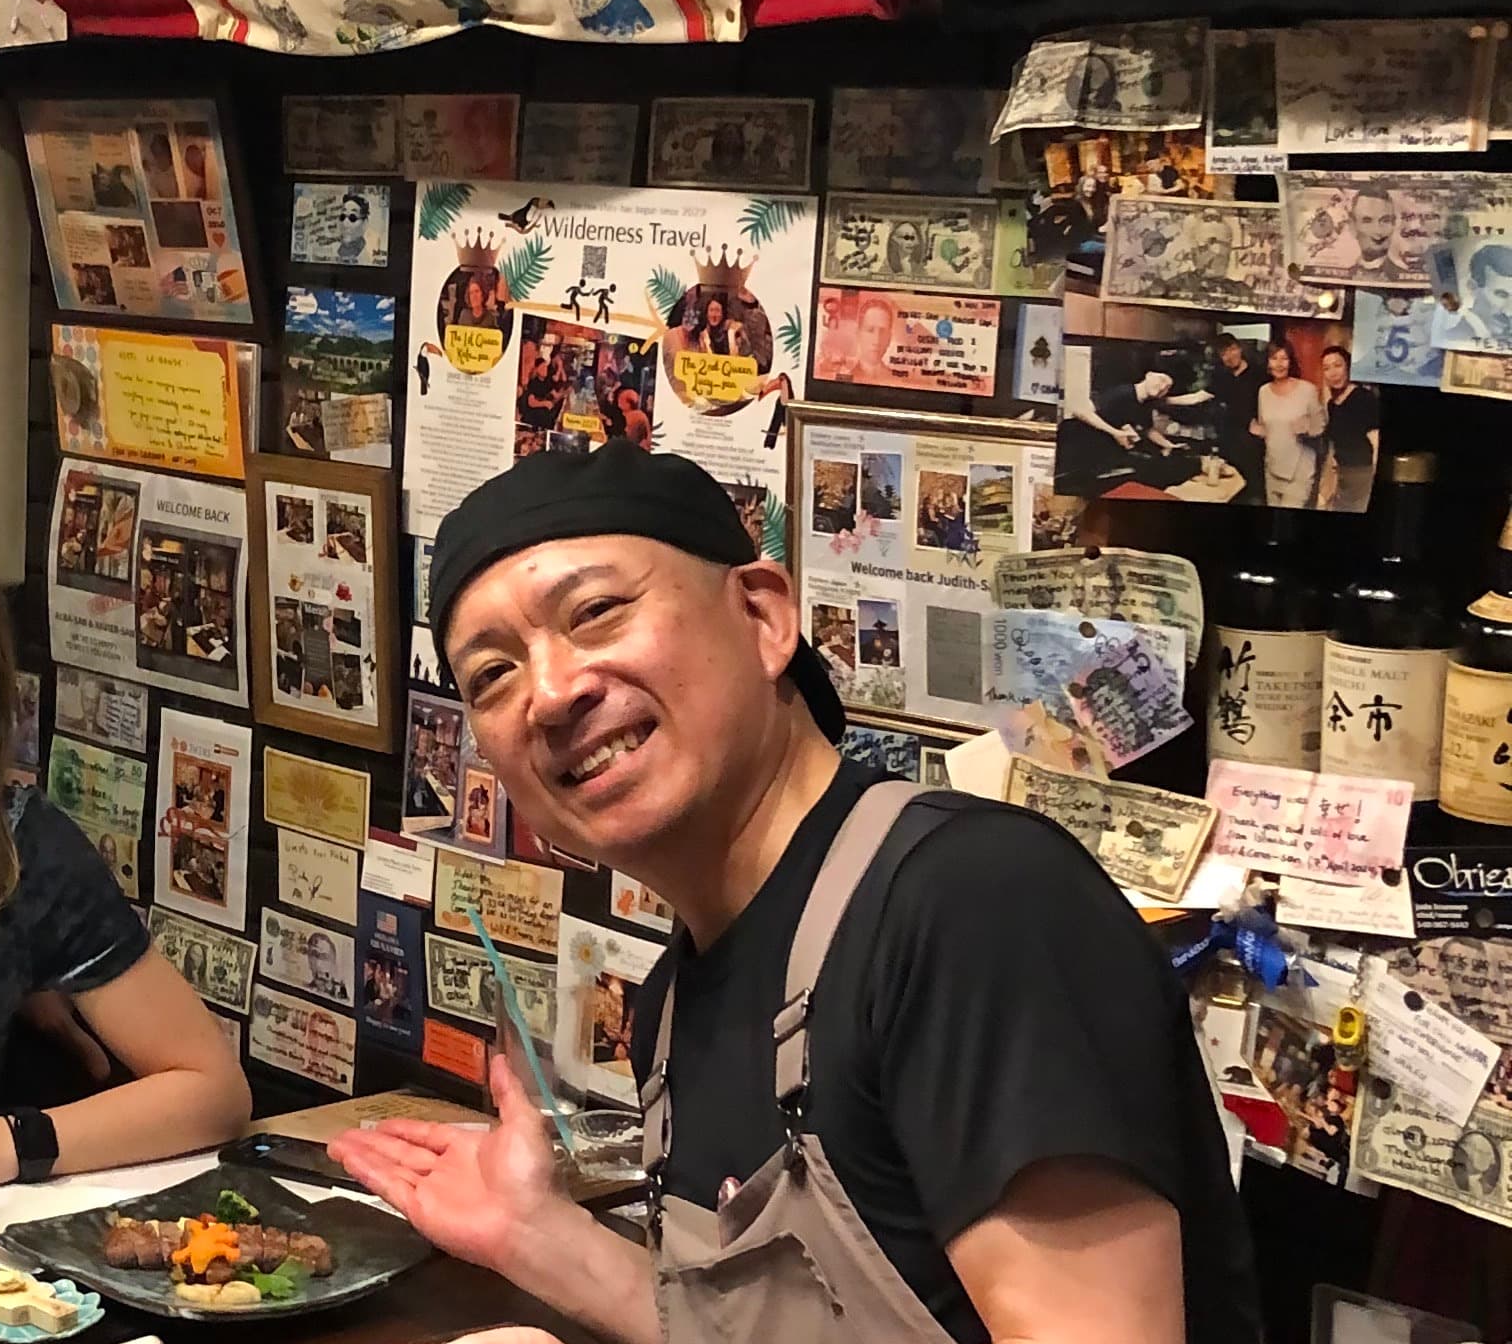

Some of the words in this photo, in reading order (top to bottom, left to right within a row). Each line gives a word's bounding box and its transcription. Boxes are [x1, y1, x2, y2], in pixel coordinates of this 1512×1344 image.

[544, 216, 643, 244] Wilderness
[649, 222, 707, 248] Travel
[681, 357, 696, 375] The
[157, 500, 202, 519] WELCOME
[204, 508, 231, 523] BACK
[851, 561, 903, 581] Welcome
[905, 568, 934, 585] back
[937, 574, 991, 592] Judith-S
[1002, 572, 1046, 584] Thank
[1370, 669, 1410, 681] MALT
